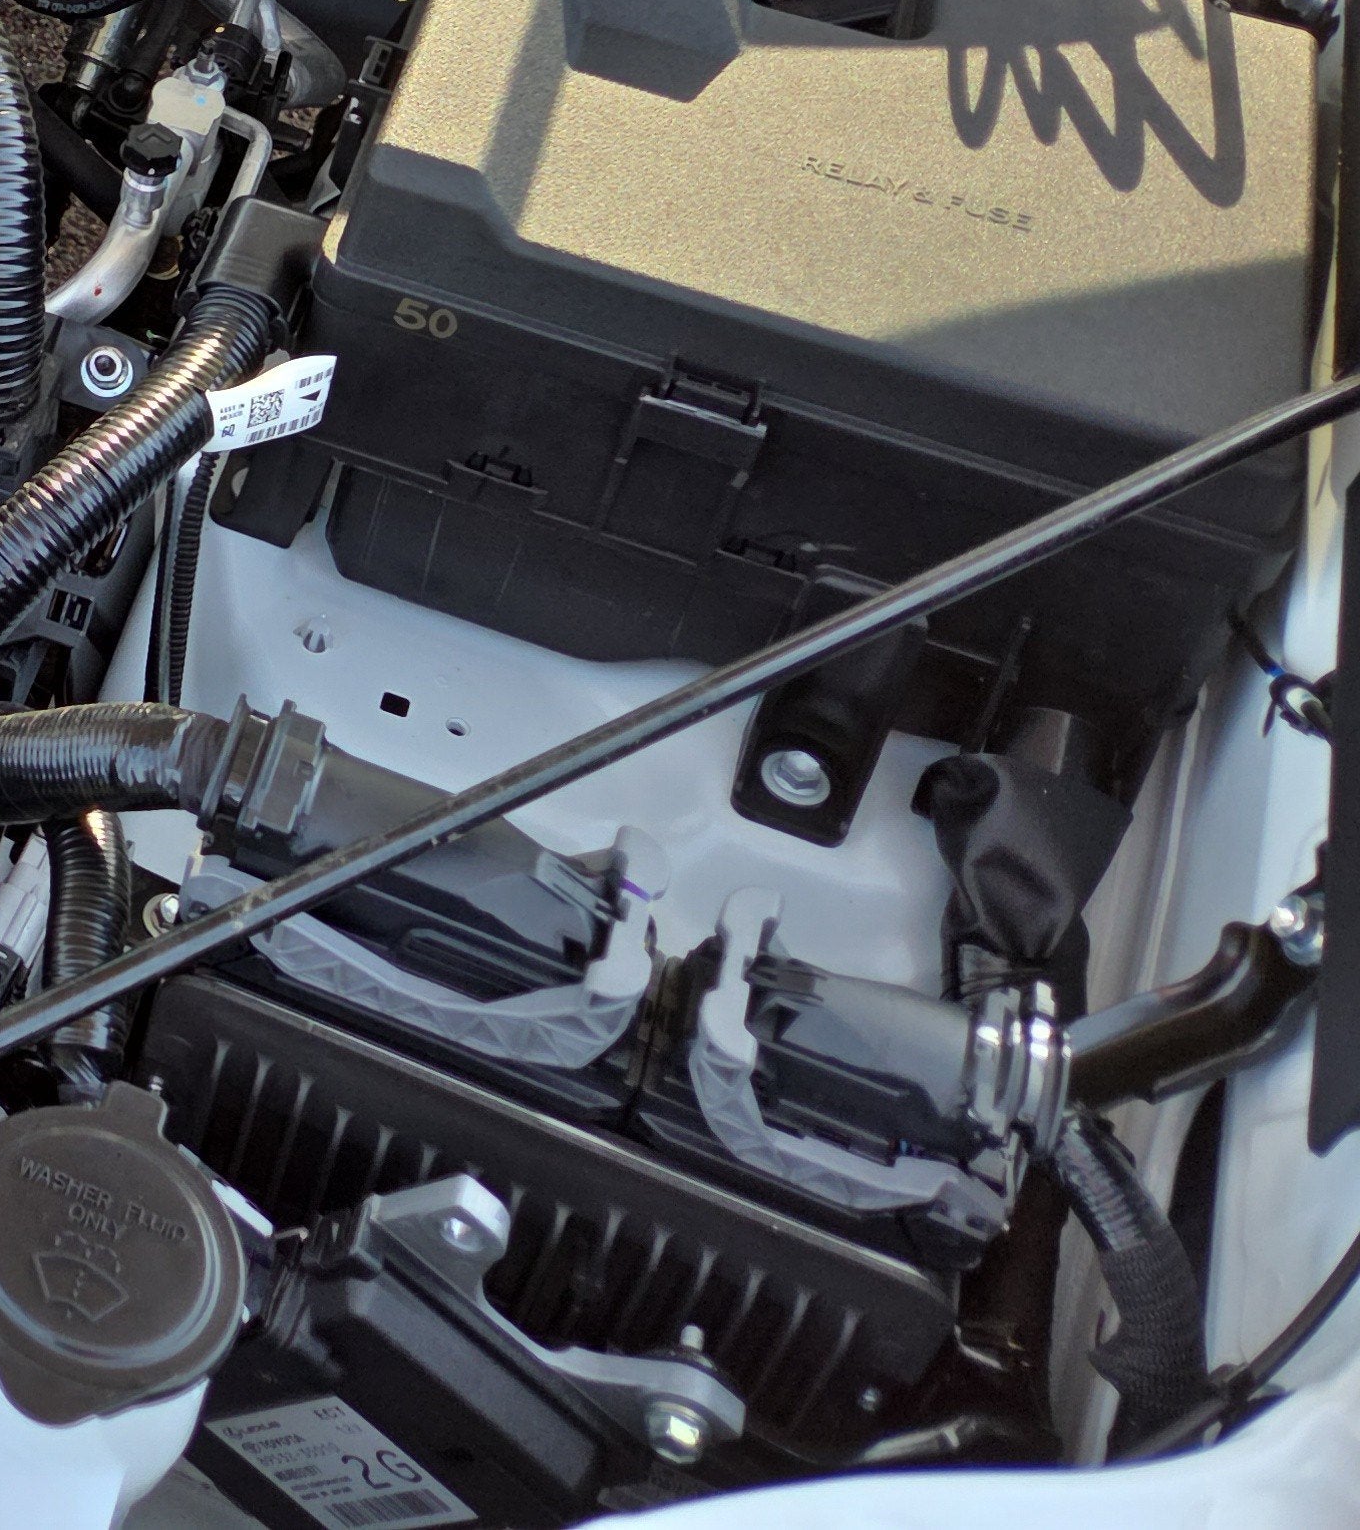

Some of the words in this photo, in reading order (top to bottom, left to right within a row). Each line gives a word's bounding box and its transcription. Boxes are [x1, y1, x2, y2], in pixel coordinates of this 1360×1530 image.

[801, 156, 909, 197] RELAY
[913, 187, 933, 206] &
[944, 194, 1033, 232] FUSE
[392, 297, 458, 339] 50
[20, 1155, 115, 1211] WASHER
[124, 1200, 190, 1243] FLUID
[67, 1201, 127, 1241] ONLY
[341, 1448, 424, 1490] 2G
